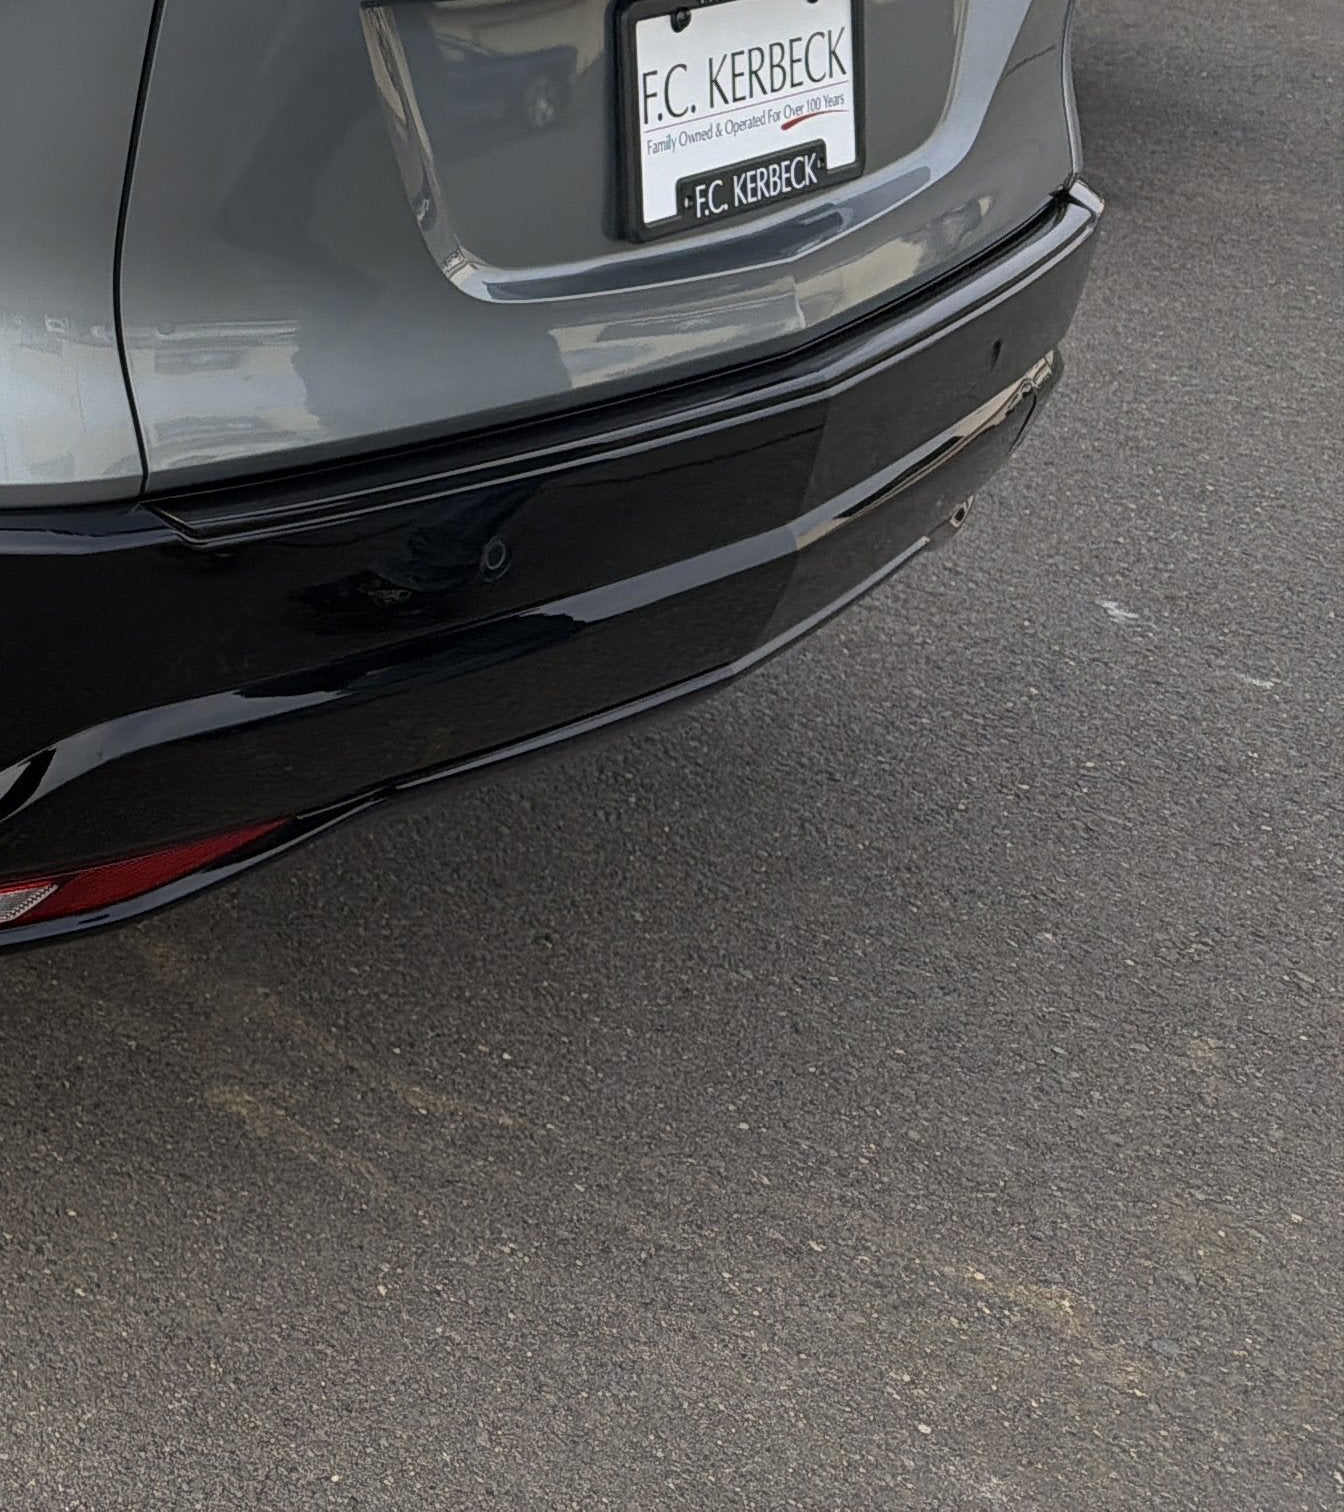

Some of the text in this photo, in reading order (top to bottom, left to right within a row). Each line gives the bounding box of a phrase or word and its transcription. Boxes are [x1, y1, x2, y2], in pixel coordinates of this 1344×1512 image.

[643, 26, 848, 125] F.C. KERBECK
[647, 93, 845, 155] Family Owned & Operated For Over 100 Years
[695, 153, 818, 219] F.C. KERBECK
